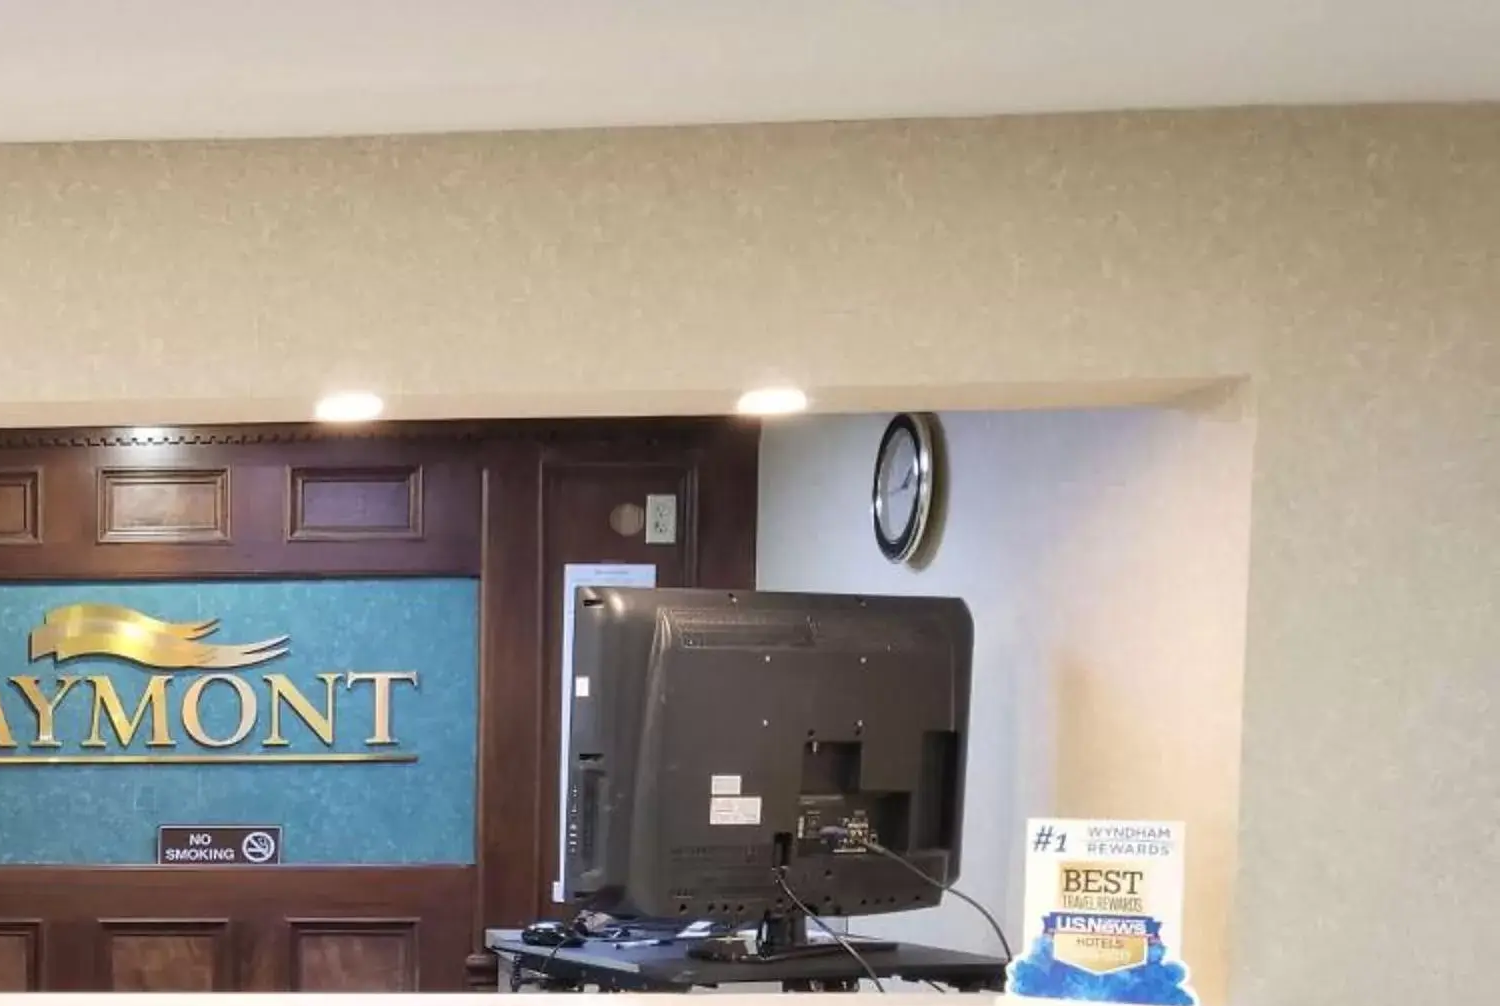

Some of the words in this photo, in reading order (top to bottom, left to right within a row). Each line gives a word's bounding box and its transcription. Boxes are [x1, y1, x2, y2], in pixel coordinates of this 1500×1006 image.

[189, 832, 213, 847] NO
[1033, 825, 1068, 853] #1
[1087, 826, 1171, 840] WYNDHAM
[164, 847, 236, 861] SMOKING
[1087, 842, 1170, 857] REWARDS
[1063, 868, 1143, 895] BEST
[1075, 936, 1125, 950] HOTELS
